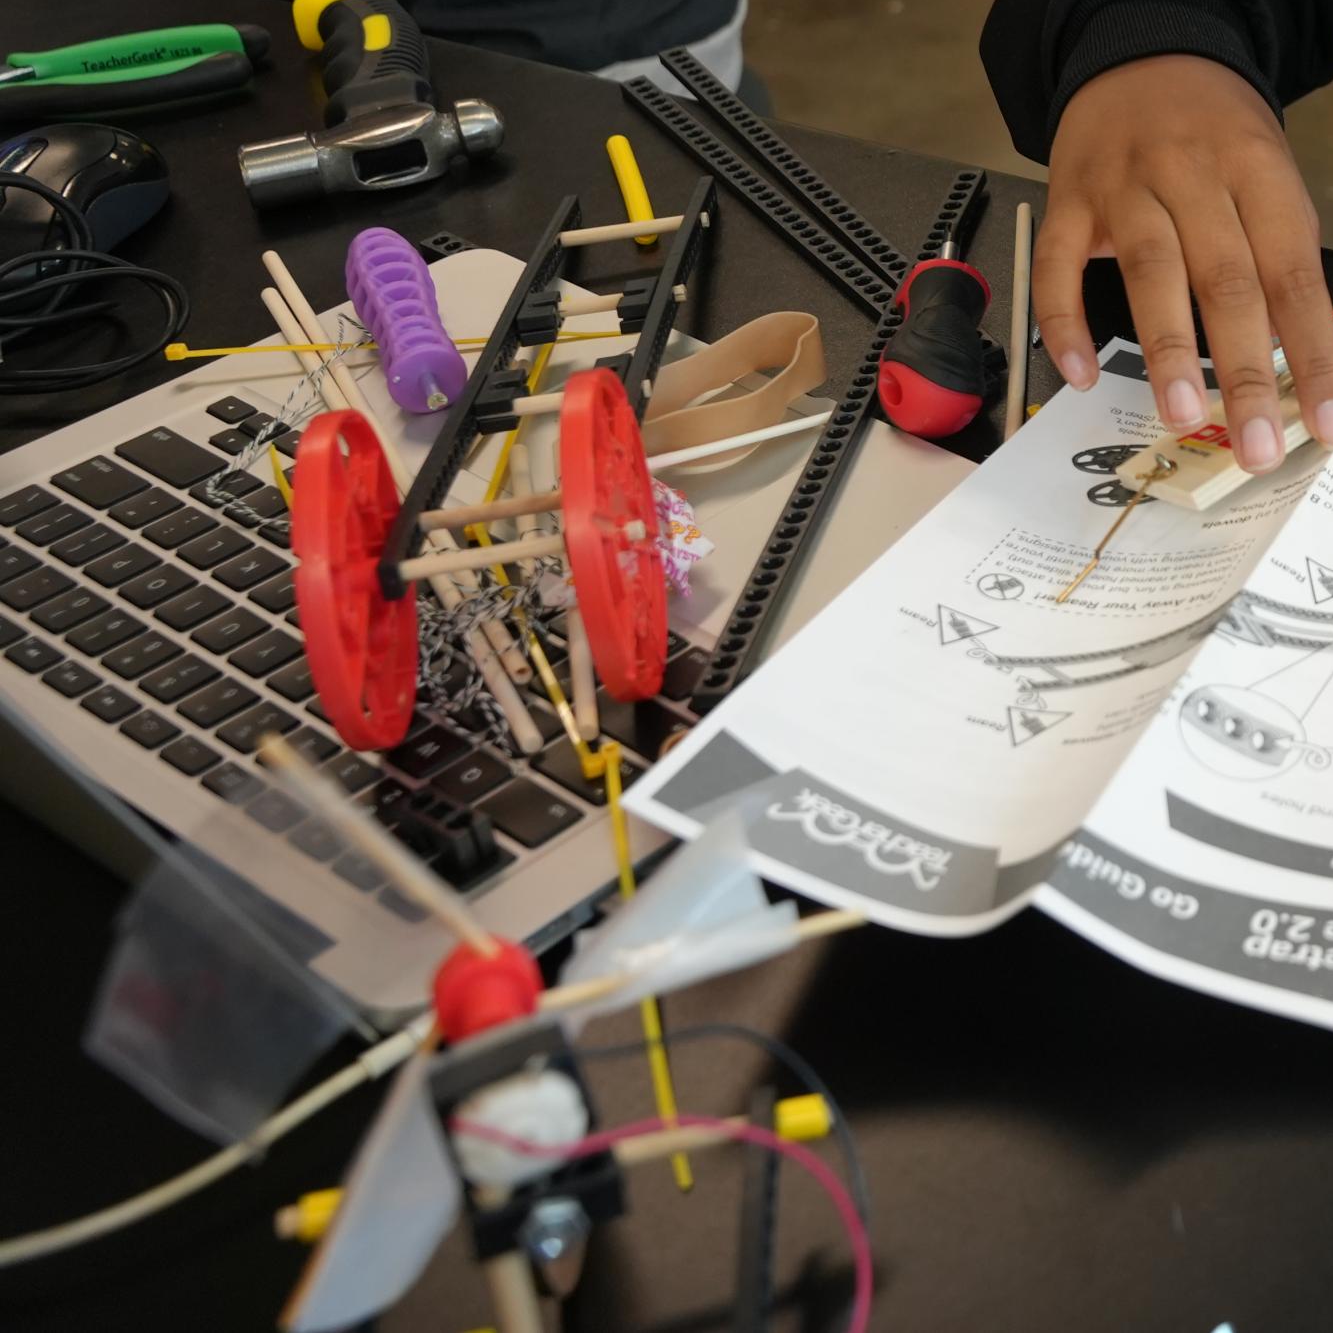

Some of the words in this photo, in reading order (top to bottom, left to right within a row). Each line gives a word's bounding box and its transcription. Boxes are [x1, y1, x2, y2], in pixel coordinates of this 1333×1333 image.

[1115, 416, 1147, 429] don't
[1124, 411, 1156, 422] (Step
[1116, 427, 1159, 440] wheels
[1201, 514, 1252, 529] dowels
[1005, 564, 1046, 580] attach
[1268, 556, 1307, 584] Ream
[1101, 601, 1138, 611] Your
[1141, 597, 1185, 609] Away
[898, 606, 938, 629] Ream
[965, 714, 1006, 734] Ream
[793, 786, 952, 874] TeacherGeek
[1150, 886, 1200, 920] Go
[1248, 908, 1315, 943] 2.0
